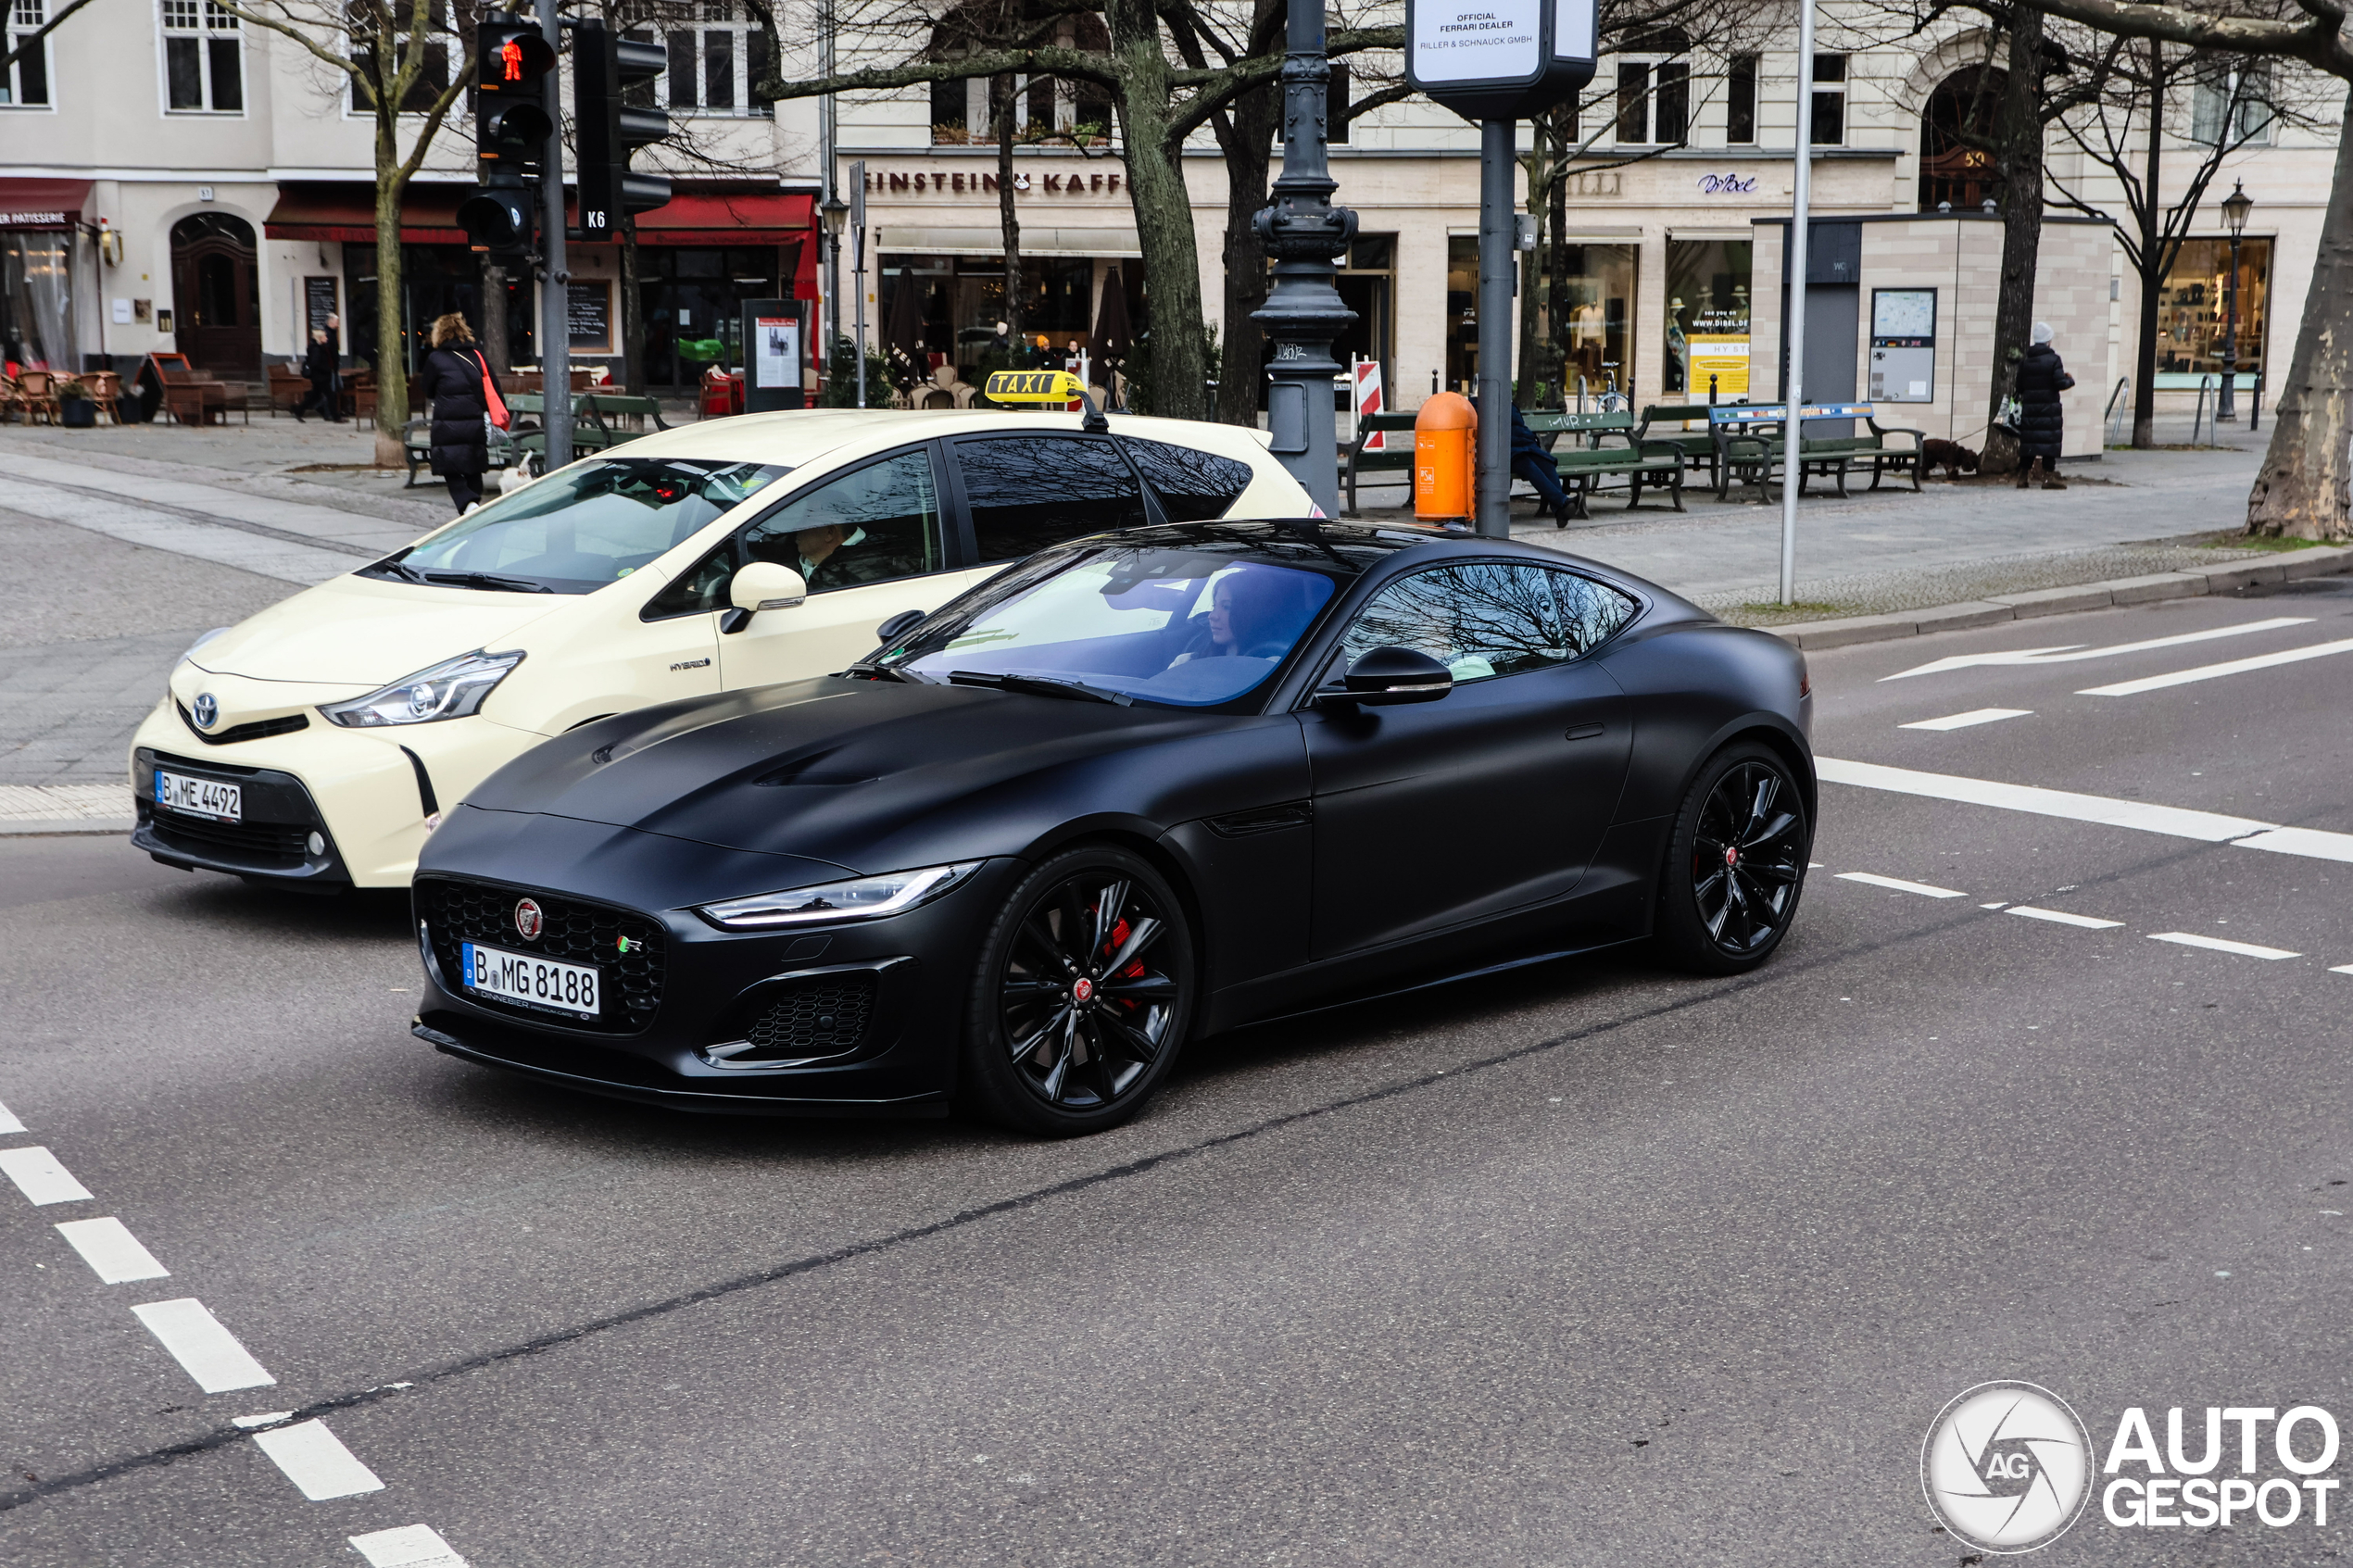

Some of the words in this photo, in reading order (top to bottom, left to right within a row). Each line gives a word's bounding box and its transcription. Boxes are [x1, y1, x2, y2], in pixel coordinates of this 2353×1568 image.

[1456, 12, 1496, 22] OFFICIAL
[1440, 23, 1478, 32] FERRARI
[1478, 21, 1514, 31] DEALER
[1420, 41, 1449, 50] RILLER
[1451, 40, 1457, 48] &
[1458, 38, 1505, 48] SCHNAUCK
[1507, 35, 1533, 44] GMBH
[1043, 173, 1131, 191] KAFF
[11, 212, 67, 224] PATISSERIE
[587, 210, 606, 228] K6
[1833, 261, 1845, 271] WC
[997, 374, 1047, 393] TAXI
[1420, 470, 1432, 482] BSR
[669, 659, 705, 671] HYBRID
[163, 776, 171, 801] B
[180, 779, 198, 808] ME
[202, 784, 239, 815] 4492
[475, 950, 487, 984] B
[501, 957, 530, 995] MG
[535, 964, 595, 1007] 8188
[480, 990, 530, 1009] DINNEBIER
